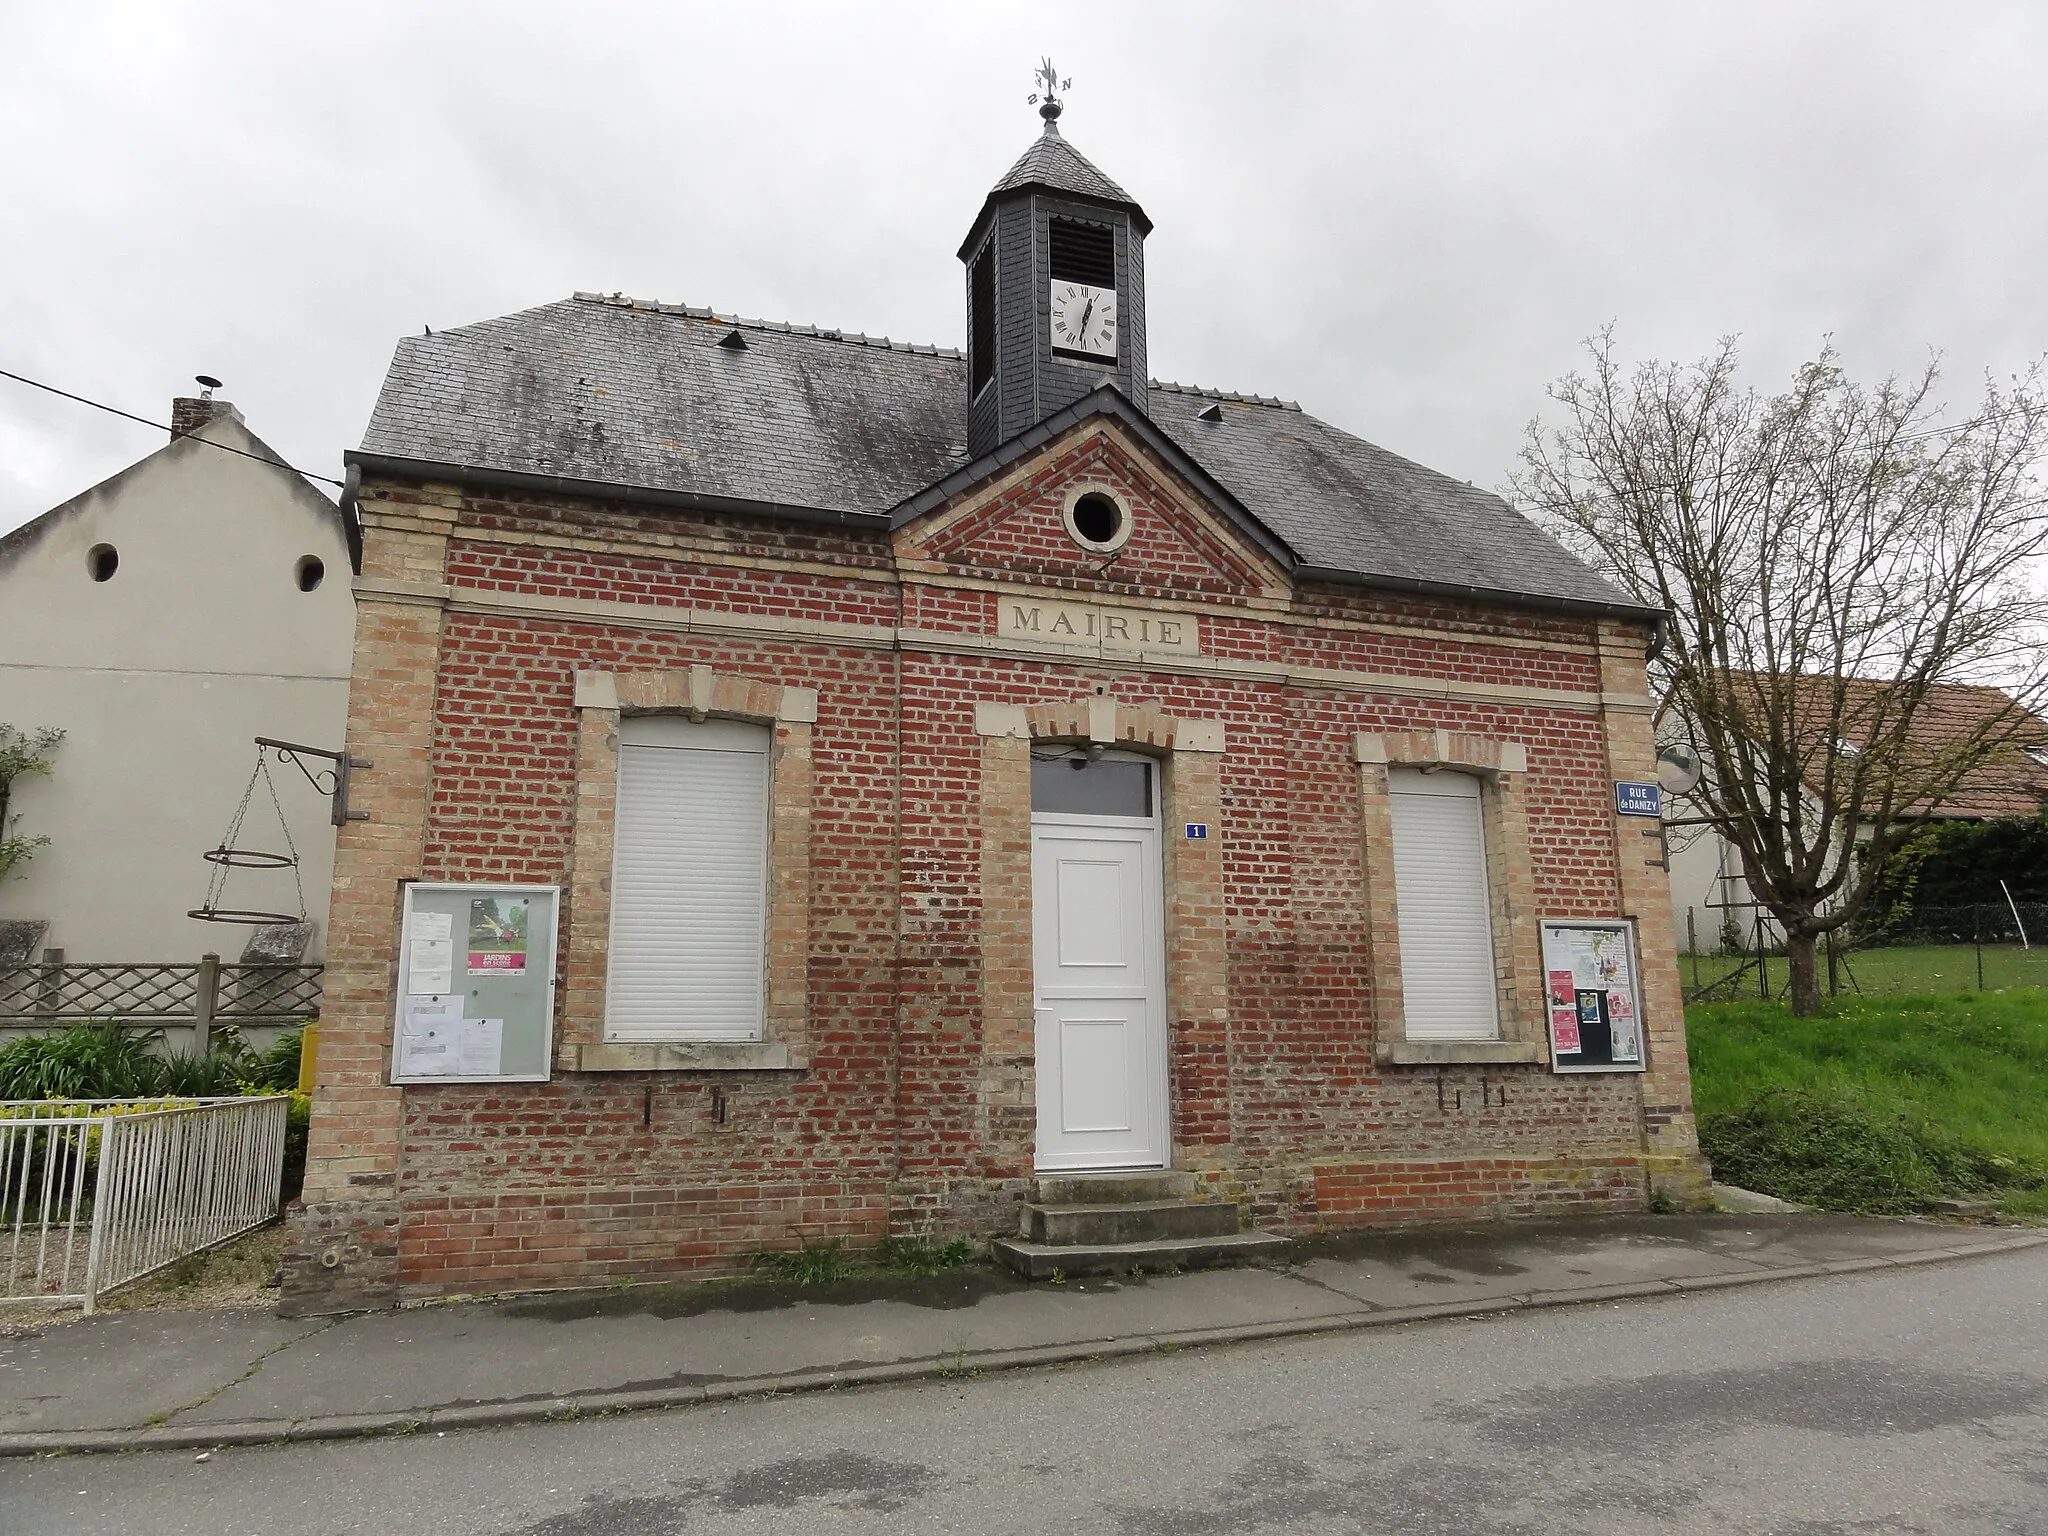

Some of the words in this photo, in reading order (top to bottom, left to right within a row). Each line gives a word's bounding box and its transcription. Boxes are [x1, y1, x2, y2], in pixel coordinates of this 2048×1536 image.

[1062, 77, 1072, 91] N
[1066, 286, 1077, 299] XI
[1080, 286, 1089, 298] XII
[1056, 296, 1068, 306] X
[1065, 331, 1076, 346] VII
[1012, 606, 1182, 645] MAIRIE
[1629, 787, 1647, 798] RUE
[1620, 799, 1628, 809] de
[1628, 800, 1657, 810] DANIZY
[1193, 826, 1200, 837] 1
